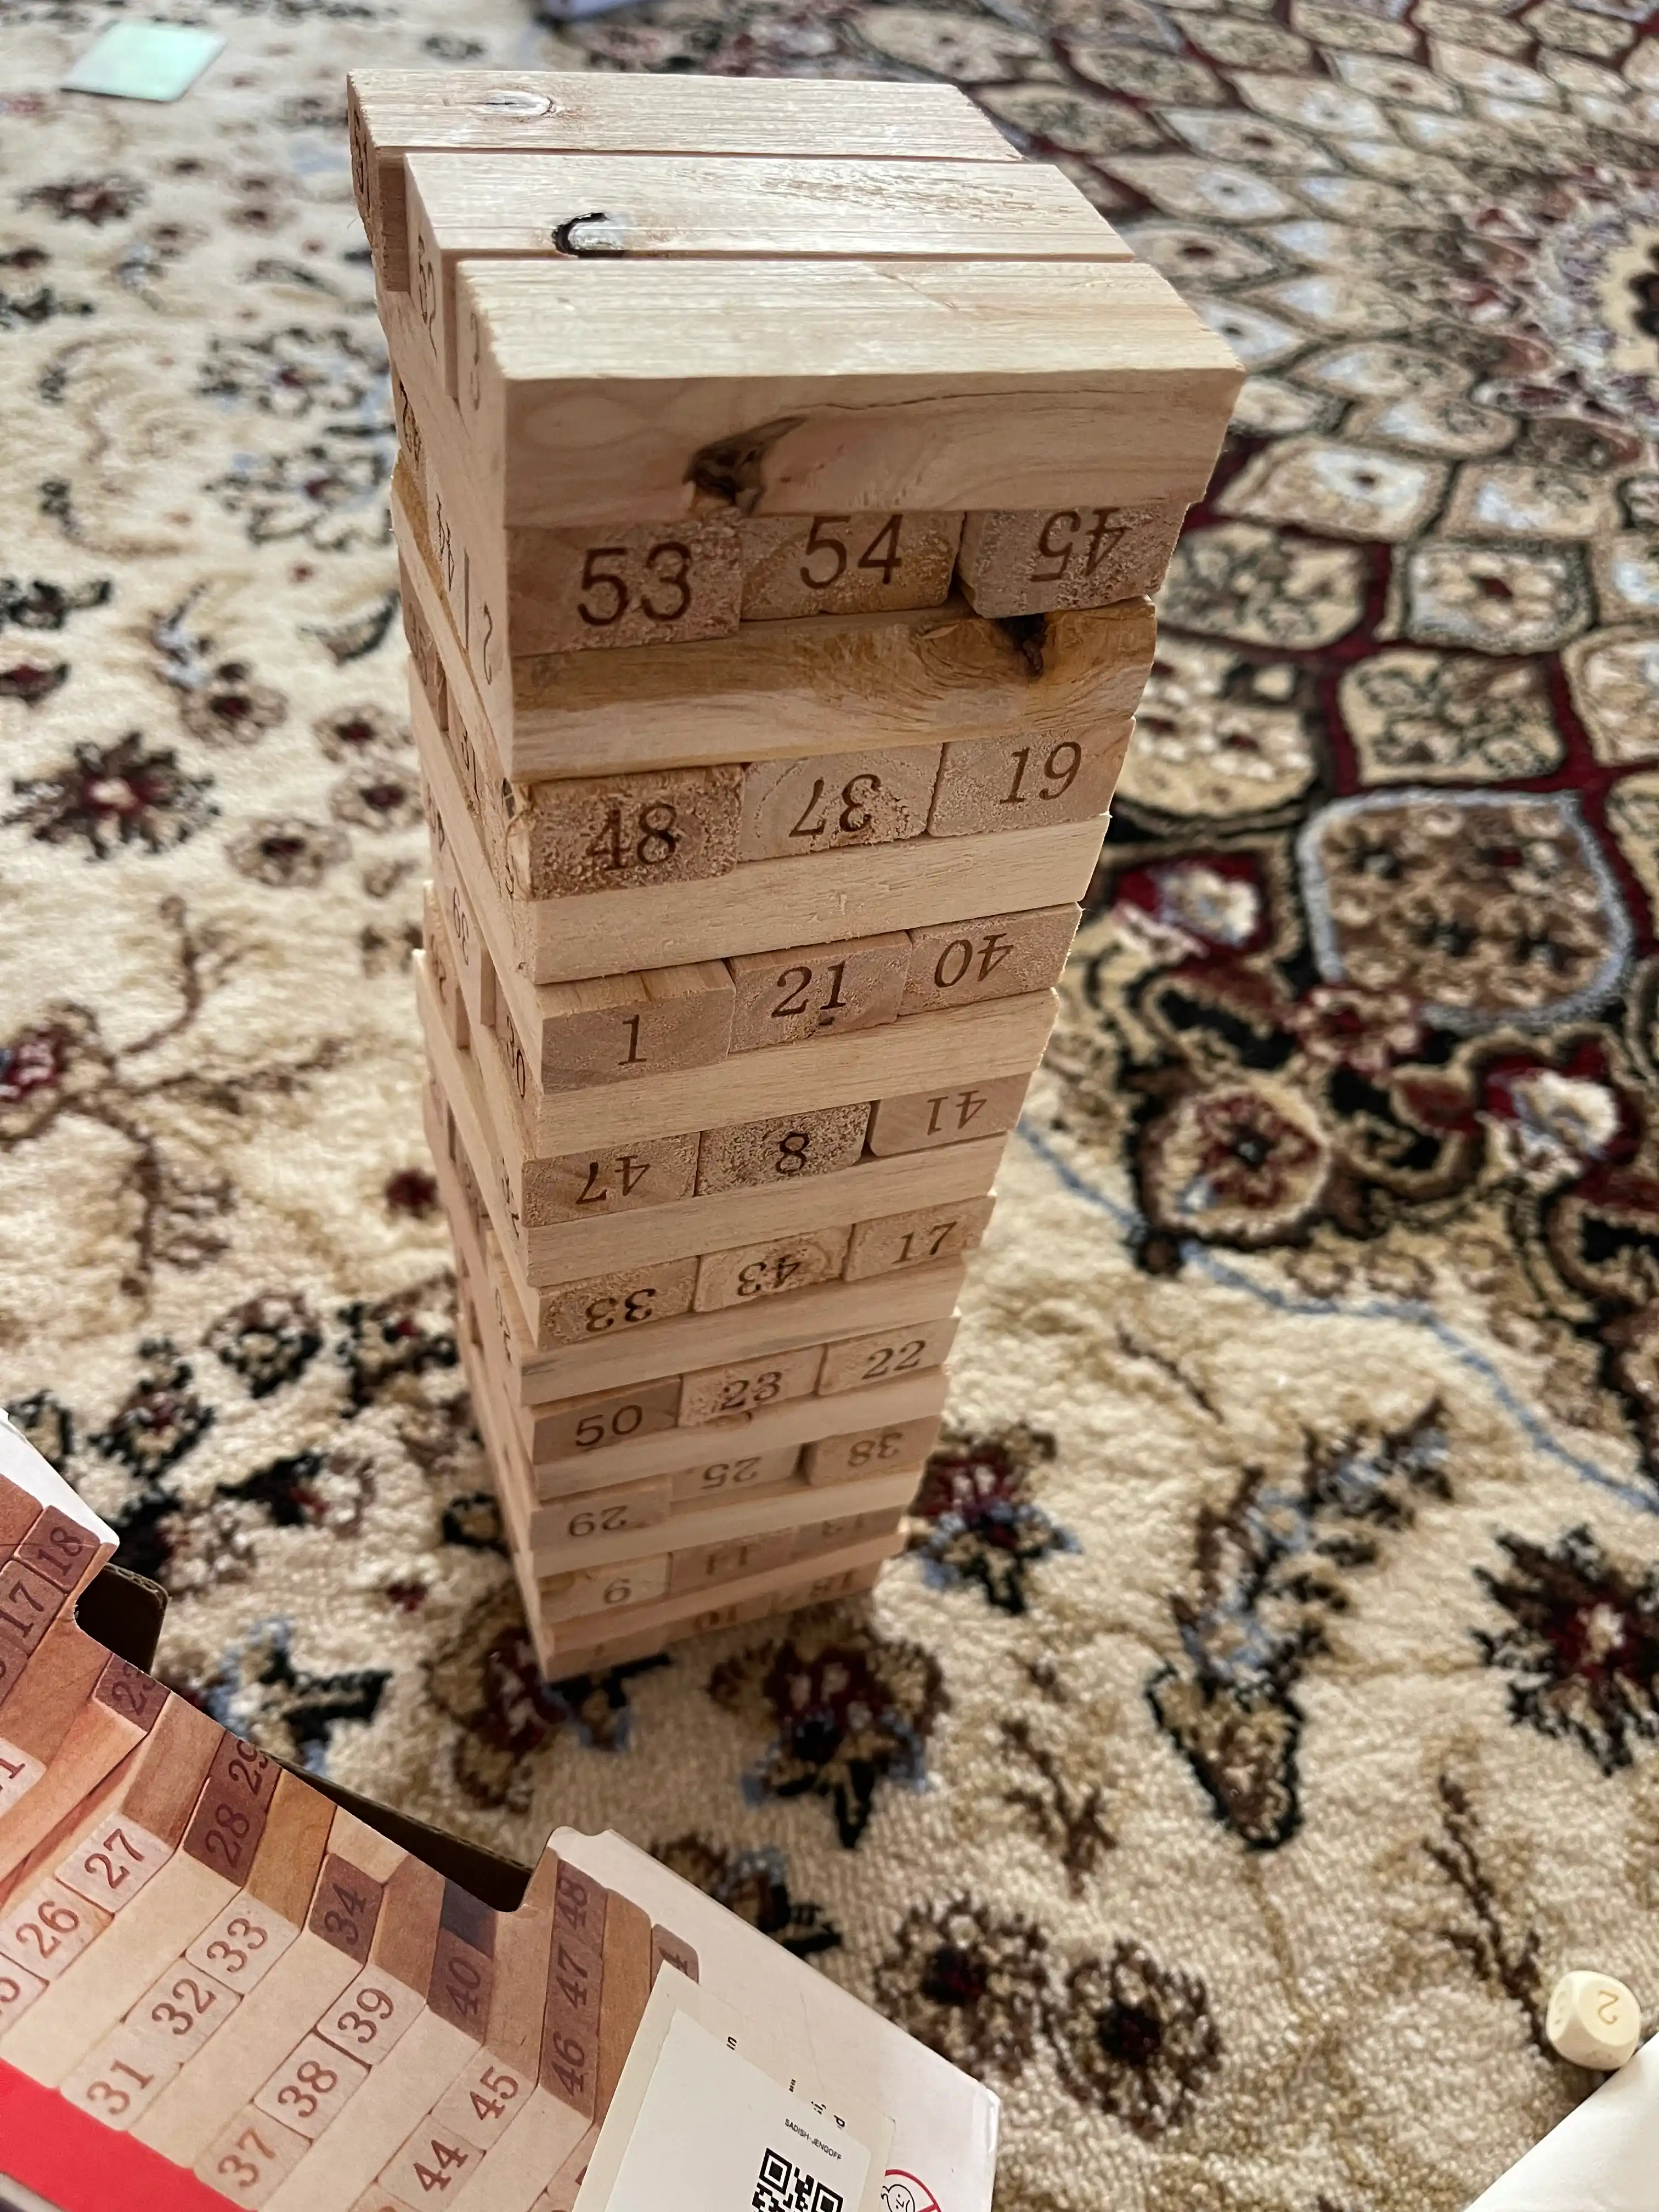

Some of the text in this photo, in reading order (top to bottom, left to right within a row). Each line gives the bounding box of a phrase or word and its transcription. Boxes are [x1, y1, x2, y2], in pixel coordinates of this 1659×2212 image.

[418, 234, 437, 358] 52
[799, 514, 904, 590] 54
[1029, 506, 1129, 583] 45
[576, 541, 692, 627] 53
[1000, 740, 1082, 806] 19
[788, 773, 883, 837] 37
[588, 801, 678, 873] 48
[933, 932, 1015, 989] 40
[770, 960, 848, 1019] 21
[506, 1014, 526, 1100] 30
[617, 1014, 647, 1066] 1
[926, 1090, 988, 1137] 41
[575, 1154, 651, 1205] 47
[775, 1132, 809, 1175] 8
[891, 1221, 958, 1265] 17
[737, 1257, 804, 1297] 43
[584, 1288, 657, 1333] 33
[861, 1339, 927, 1381] 22
[720, 1371, 782, 1412] 23
[574, 1404, 644, 1448] 50
[847, 1432, 904, 1469] 38
[700, 1456, 763, 1491] 25
[37, 1524, 86, 1576] 18
[0, 1581, 44, 1638] 17
[84, 1828, 146, 1889] 27
[205, 1803, 251, 1865] 28
[15, 1900, 80, 1956] 26
[324, 1882, 367, 1948] 34
[556, 1876, 588, 1930] 48
[206, 1917, 269, 1974] 33
[445, 1956, 482, 2017] 40
[555, 1944, 588, 2009] 47
[151, 1978, 216, 2036] 32
[338, 1987, 395, 2045] 39
[1596, 1989, 1620, 2025] 2
[86, 2059, 156, 2119] 31
[277, 2060, 338, 2119] 38
[470, 2066, 520, 2120] 45
[551, 2032, 586, 2097] 46
[218, 2127, 276, 2189] 37
[413, 2140, 469, 2192] 44
